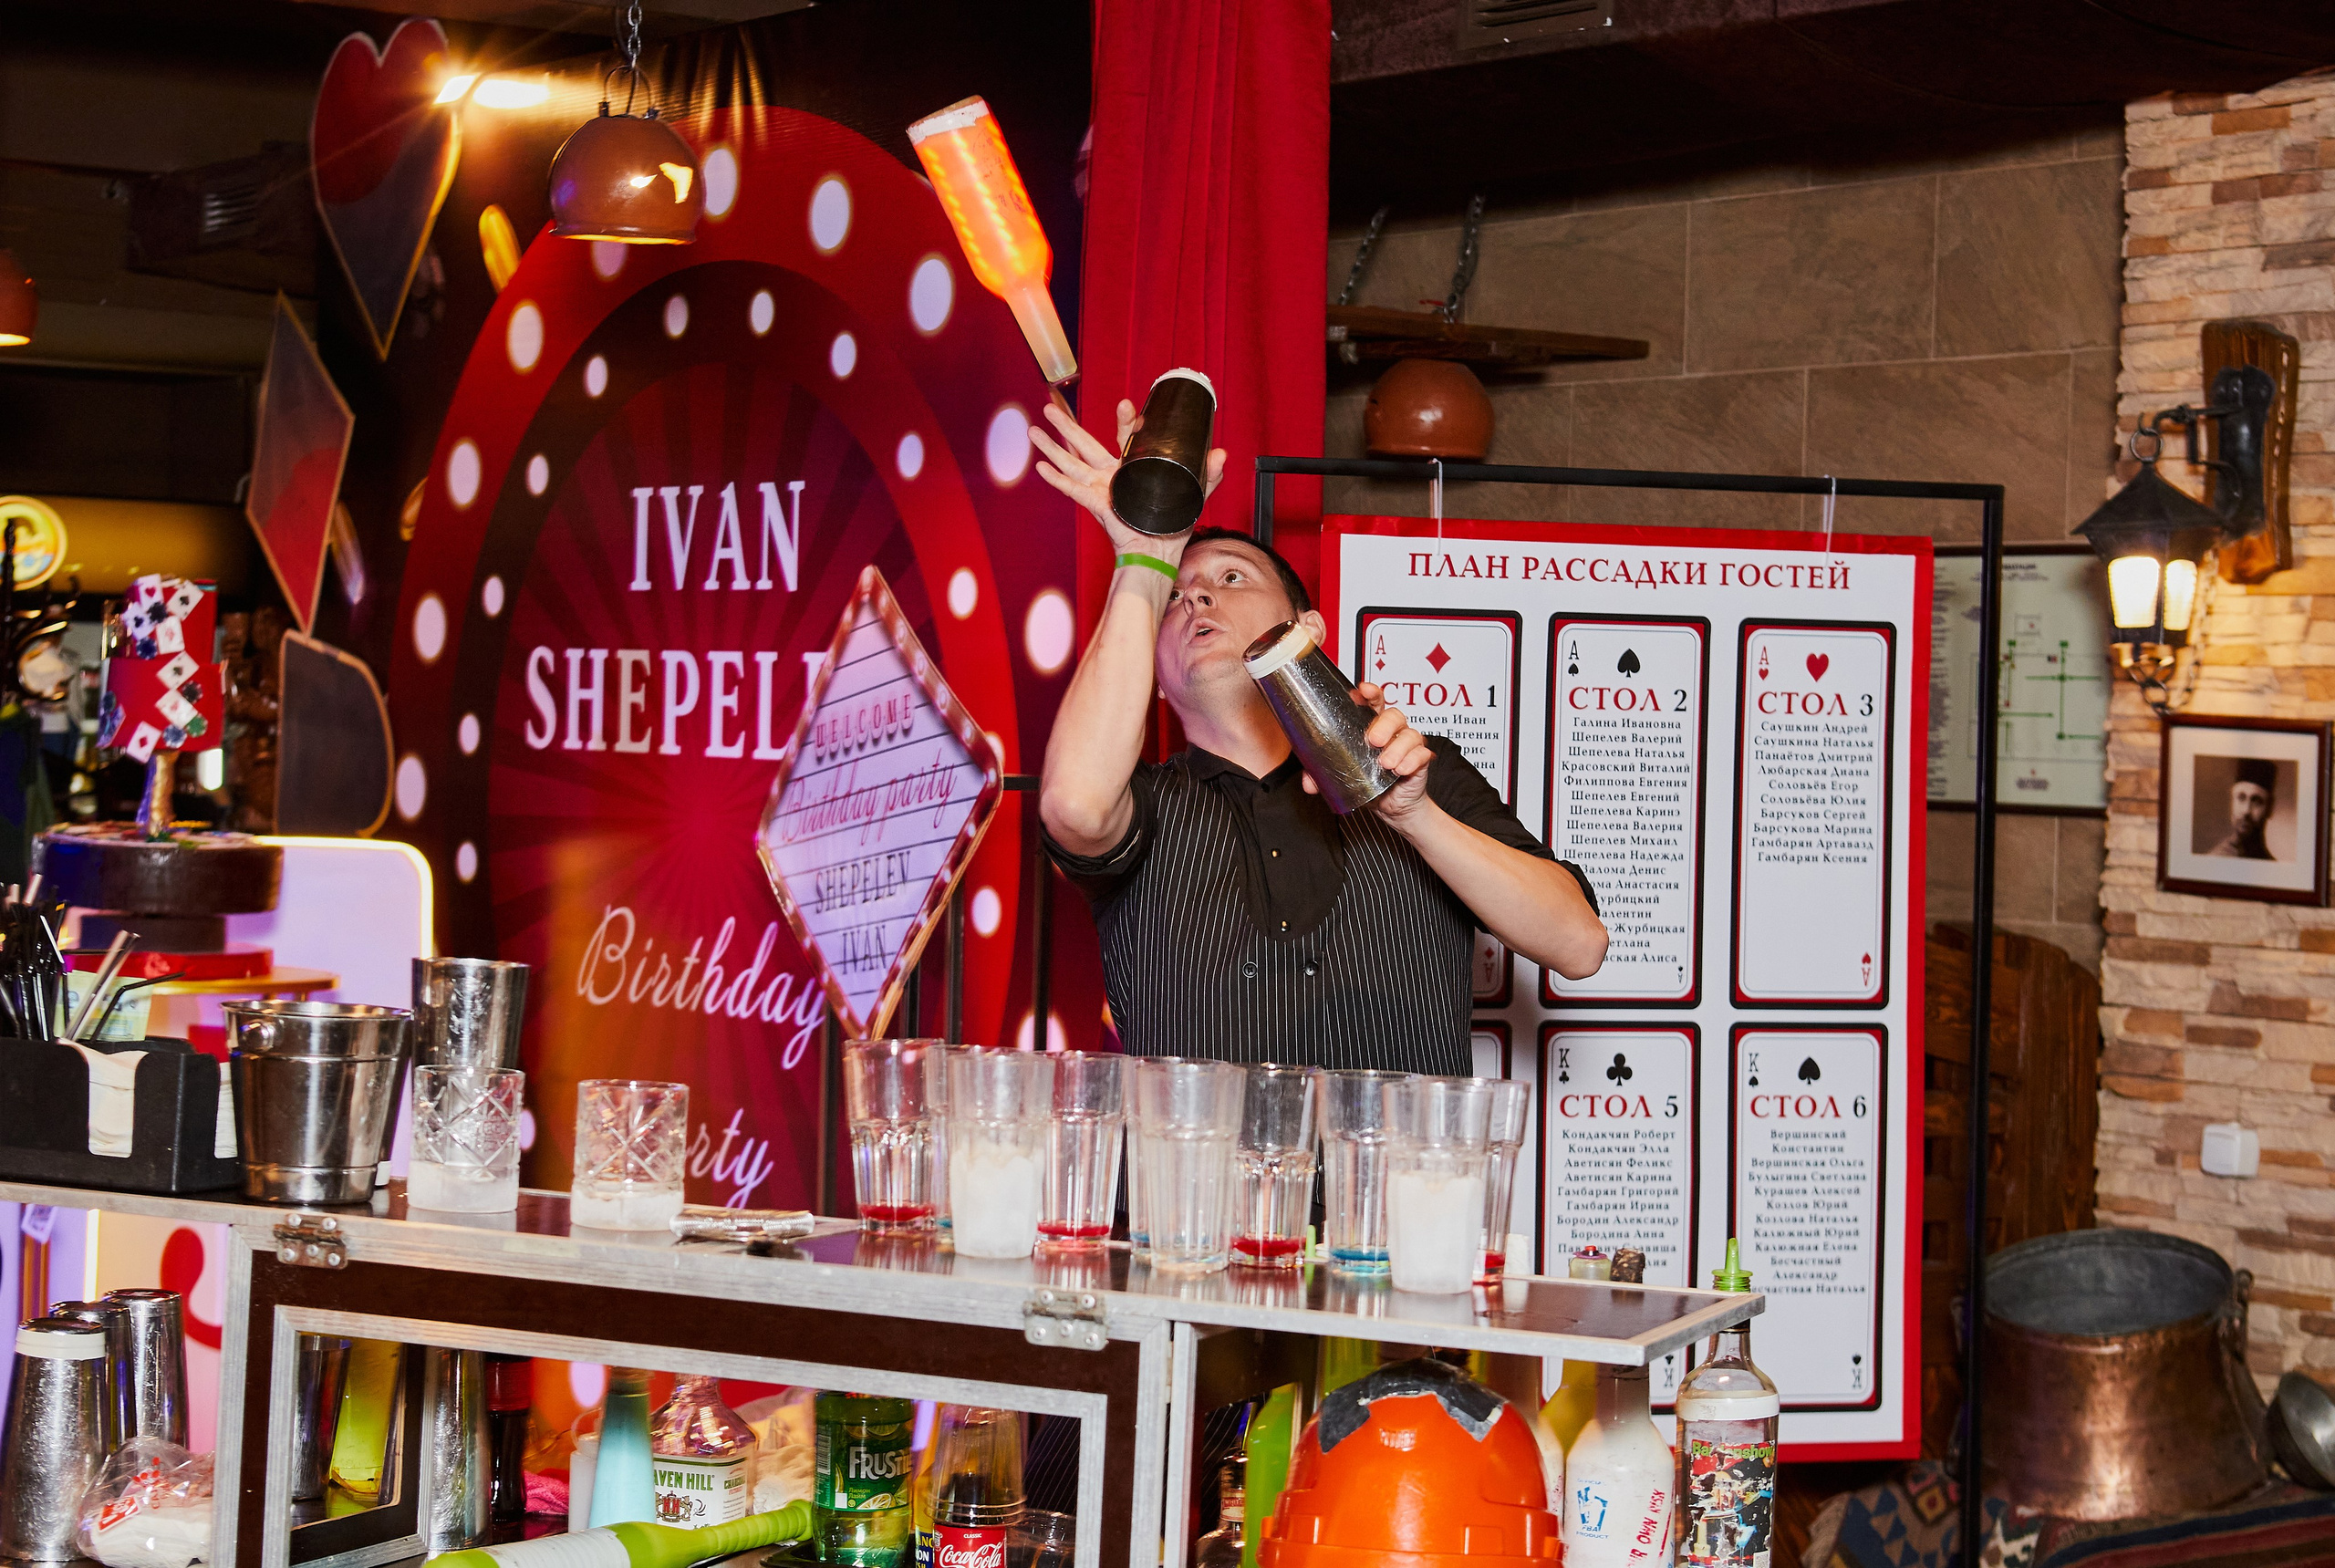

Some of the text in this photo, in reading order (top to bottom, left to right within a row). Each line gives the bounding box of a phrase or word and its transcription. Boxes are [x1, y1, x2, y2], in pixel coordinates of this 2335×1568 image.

[628, 480, 805, 592] IVAN
[1408, 553, 1851, 590] ПЛАН РАССАДКИ ГОСТЕЙ
[1375, 634, 1386, 655] A
[1568, 640, 1580, 659] A
[1759, 646, 1769, 665] A
[1380, 681, 1498, 708] СТОЛ 1
[1568, 686, 1687, 711] СТОЛ 2
[524, 645, 827, 761] SHEPEL
[1758, 691, 1873, 716] СТОЛ 3
[815, 693, 912, 749] WELCOME
[1453, 714, 1486, 725] Иван
[1573, 717, 1681, 729] Галина Ивановна
[1447, 729, 1500, 740] Евгения
[1760, 722, 1867, 735] Саушкин Андрей
[1572, 732, 1682, 745] Шепелев Валерий
[1754, 736, 1873, 748] Саушкина Наталья
[1568, 746, 1685, 758] Шепелева Наталья
[1755, 750, 1873, 763] Панаётов Дмитрий
[1562, 761, 1690, 774] Красовский Виталий
[1758, 765, 1870, 777] Любарская Диана
[1564, 775, 1687, 787] Филиппова Евгения
[1769, 780, 1859, 793] Соловьёв Егор
[782, 747, 958, 846] Birthday party
[1572, 790, 1679, 802] Шепелев Евгений
[1760, 794, 1866, 805] Соловьёва Юлия
[1570, 805, 1680, 818] Шепелева Каринэ
[1761, 808, 1865, 821] Барсуков Сергей
[1567, 819, 1683, 833] Шепелева Валерия
[1753, 823, 1872, 836] Барсукова Марина
[1571, 835, 1678, 846] Шепелев Михаил
[1751, 837, 1873, 850] Гамбарян Артавазд
[1563, 849, 1684, 861] Шепелева Надежда
[1758, 852, 1867, 864] Гамбарян Ксения
[1629, 866, 1666, 877] Денис
[815, 850, 911, 914] SHEPELEV
[1615, 878, 1679, 889] Анастасия
[1597, 893, 1660, 906] урбицкий
[1601, 909, 1652, 919] алентин
[842, 925, 887, 975] IVAN
[1640, 952, 1677, 962] Алиса
[576, 904, 826, 1070] Birthday
[1560, 1095, 1678, 1118] СТОЛ 5
[1750, 1095, 1866, 1118] СТОЛ 6
[1562, 1129, 1676, 1140] Кондакчян Роберт
[1770, 1129, 1846, 1140] Вершинский
[1569, 1143, 1669, 1154] Кондакчян Элла
[1772, 1143, 1844, 1153] Константин
[1564, 1158, 1672, 1168] Аветисян Феликс
[1751, 1158, 1825, 1168] Вершинская
[1564, 1172, 1672, 1183] Аветисян Карина
[1558, 1187, 1678, 1198] Гамбарян Григорий
[1567, 1200, 1669, 1211] Гамбарян Ирина
[1812, 1199, 1847, 1210] Юрий
[1557, 1215, 1678, 1226] Бородин Александр
[1571, 1229, 1665, 1241] Бородина Анна
[1751, 1285, 1811, 1293] есчастная
[1636, 1517, 1658, 1544] OWN
